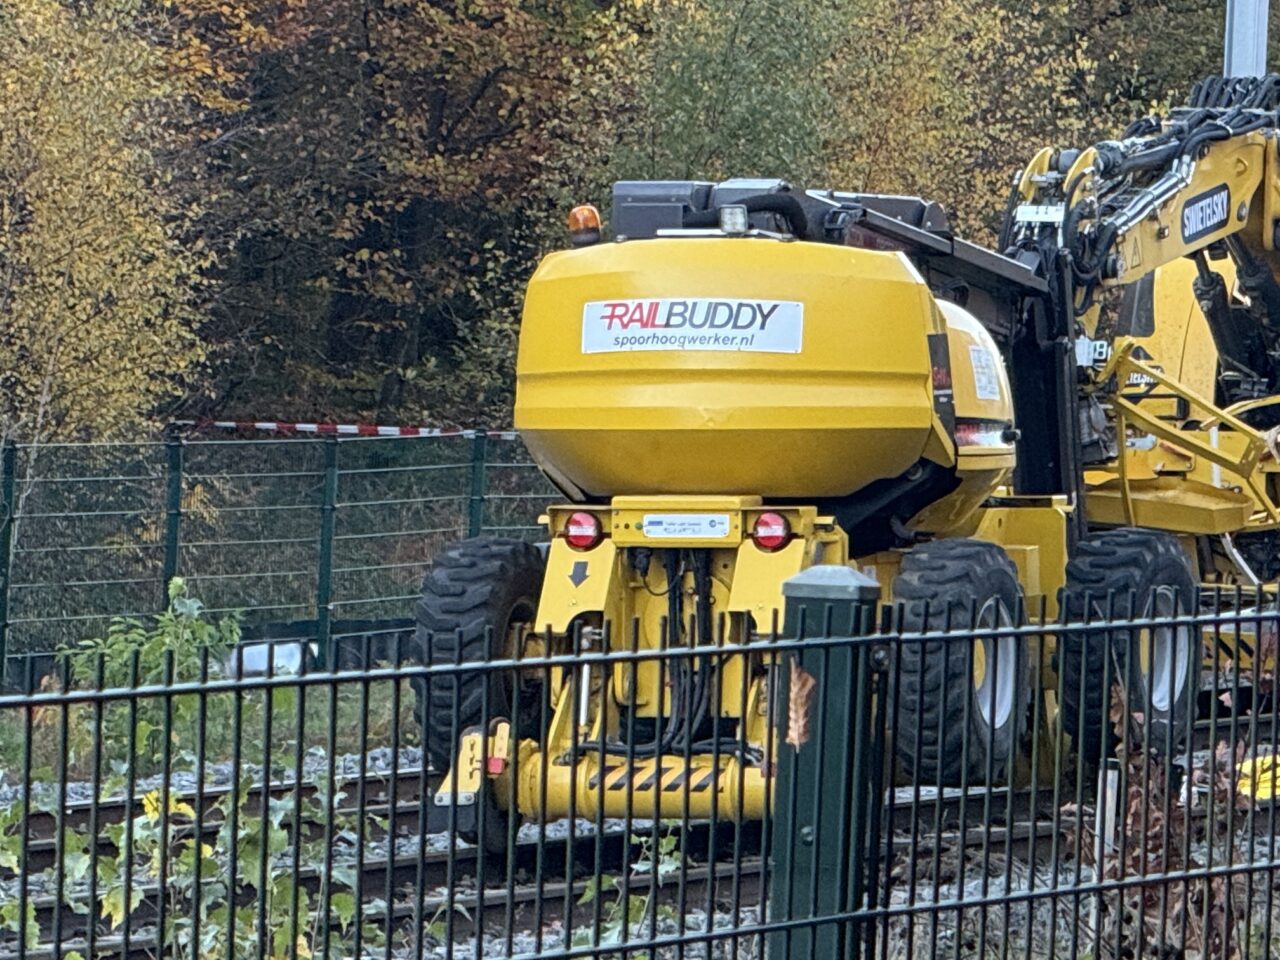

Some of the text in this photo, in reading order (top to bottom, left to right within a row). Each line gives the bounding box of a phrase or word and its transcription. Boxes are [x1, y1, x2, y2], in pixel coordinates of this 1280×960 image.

[1184, 189, 1228, 237] SWIETELSKY
[600, 301, 779, 330] RAILBUDDY
[613, 333, 755, 349] spoorhoogwerker.nl
